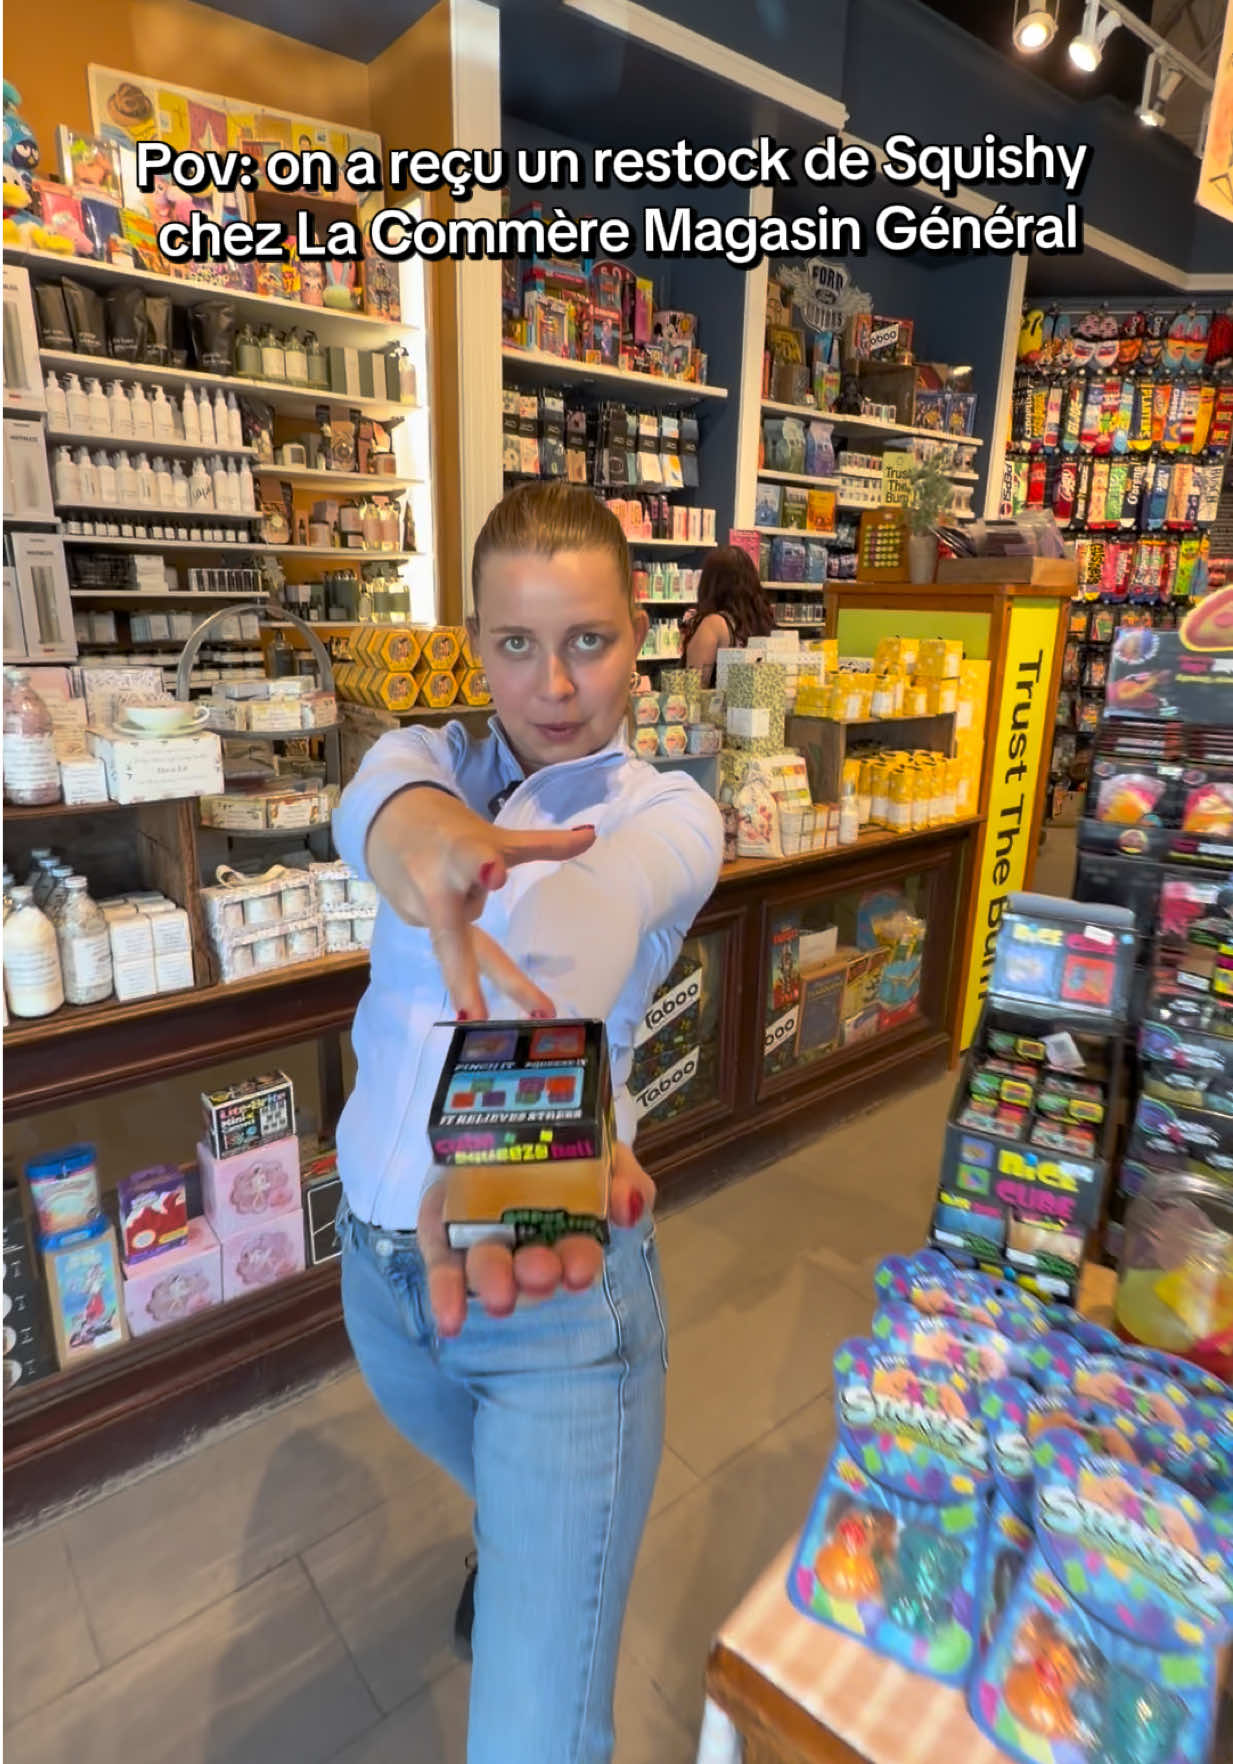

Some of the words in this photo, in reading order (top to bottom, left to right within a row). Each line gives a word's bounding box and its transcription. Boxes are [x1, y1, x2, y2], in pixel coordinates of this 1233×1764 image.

[812, 265, 844, 289] FORD
[1002, 462, 1013, 501] PEPSI
[1005, 649, 1043, 784] Trust
[992, 793, 1024, 886] The
[636, 1060, 695, 1107] Taboo
[440, 1114, 453, 1125] IT
[455, 1111, 527, 1125] RELIEVES
[528, 1109, 582, 1121] STRESS
